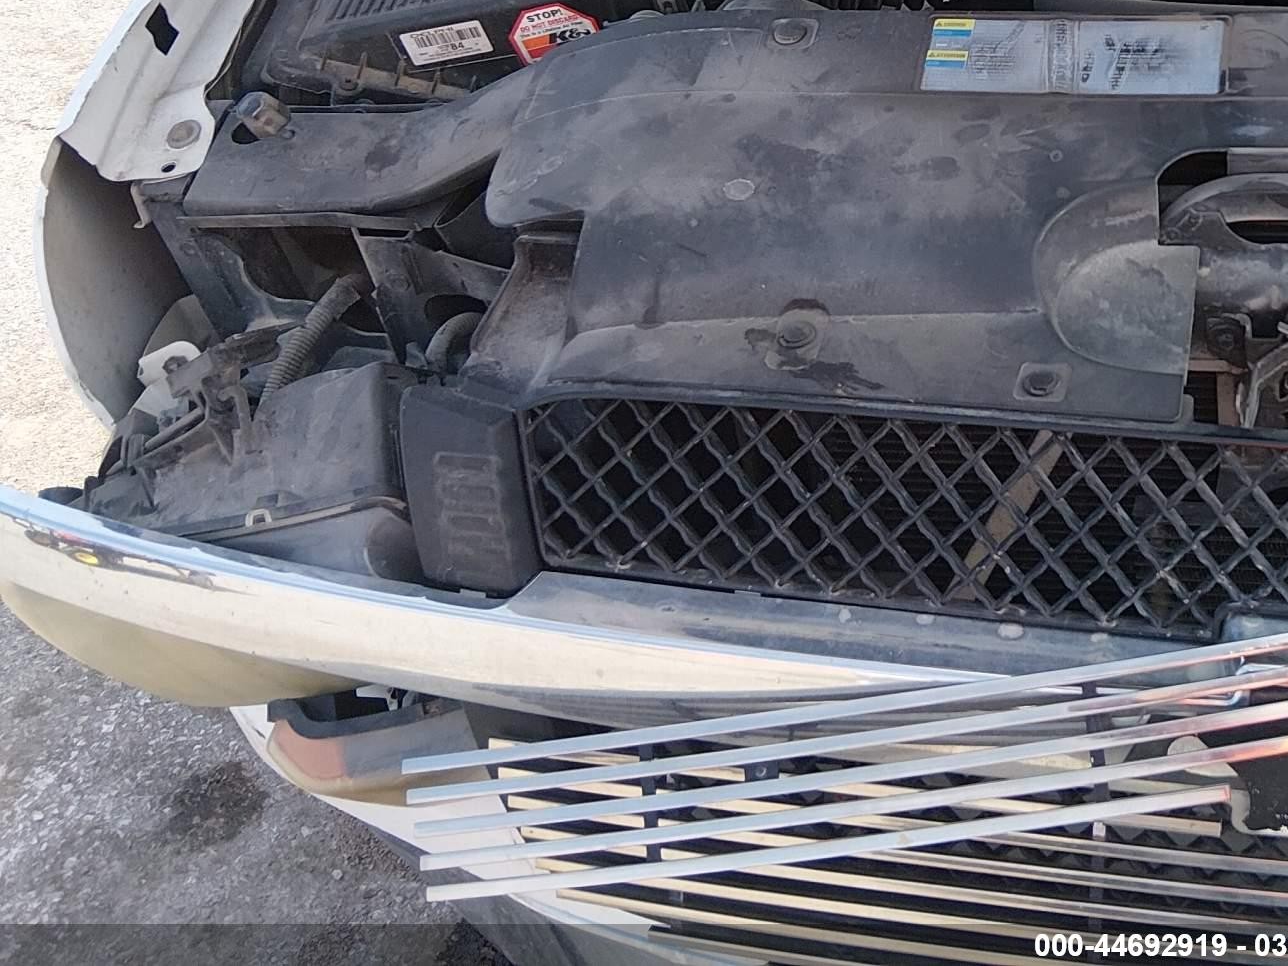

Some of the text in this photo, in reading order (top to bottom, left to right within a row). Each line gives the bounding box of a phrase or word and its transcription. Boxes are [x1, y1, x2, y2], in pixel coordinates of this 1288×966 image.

[520, 14, 579, 33] DO NOT DISCARD
[526, 8, 563, 23] STOP!
